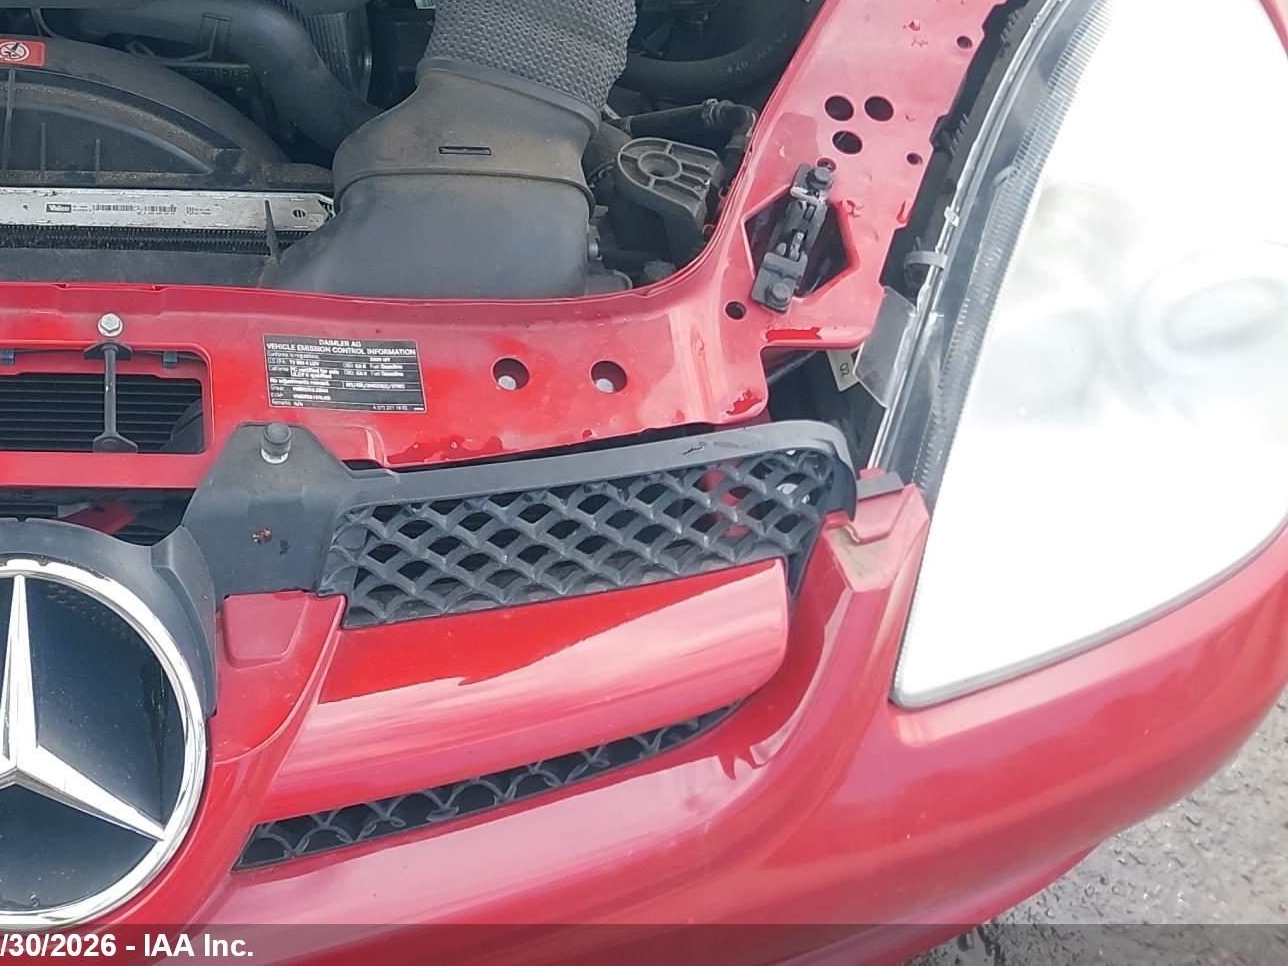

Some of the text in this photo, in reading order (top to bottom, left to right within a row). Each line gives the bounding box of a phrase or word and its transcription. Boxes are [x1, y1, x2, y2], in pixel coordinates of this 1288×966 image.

[318, 339, 350, 347] DAIMLER
[266, 343, 416, 356] VEHICLE EMISSION CONTROL INFORMATION
